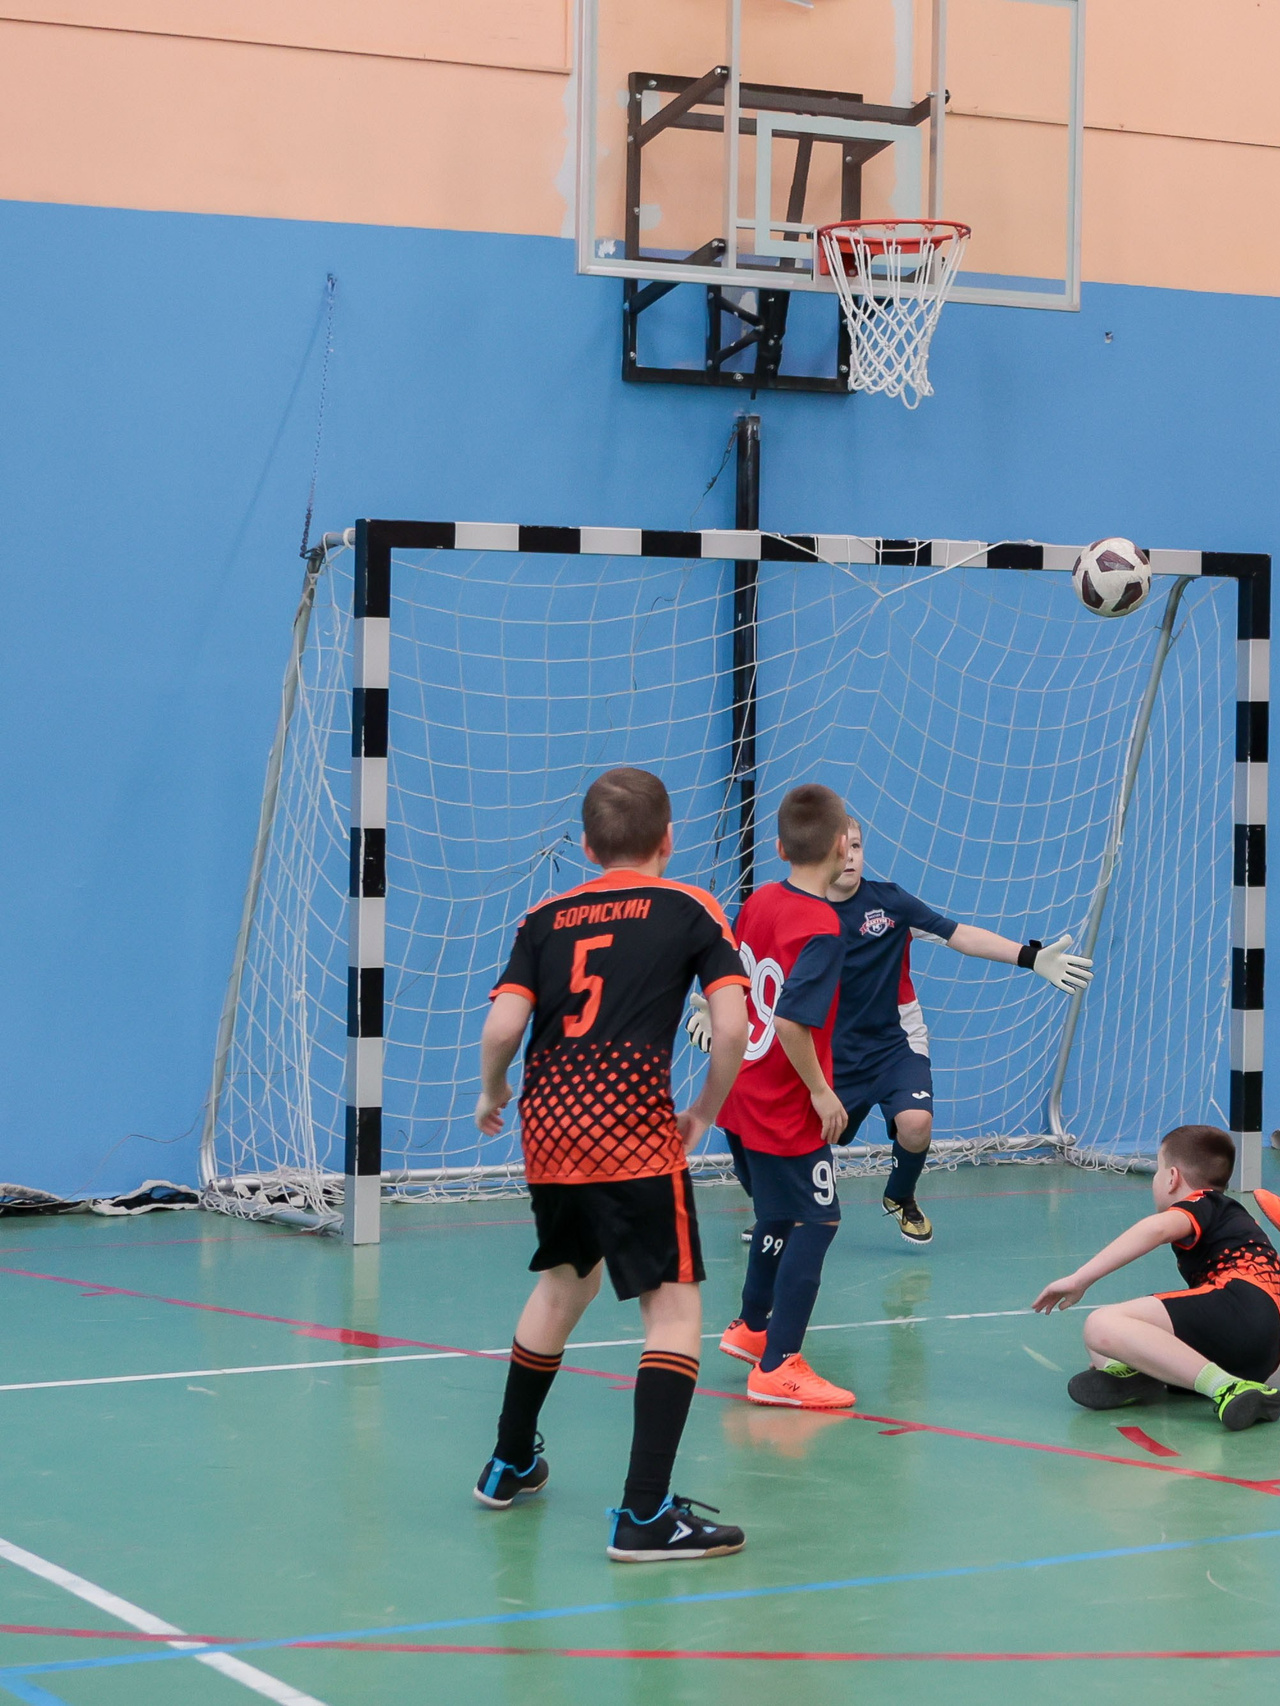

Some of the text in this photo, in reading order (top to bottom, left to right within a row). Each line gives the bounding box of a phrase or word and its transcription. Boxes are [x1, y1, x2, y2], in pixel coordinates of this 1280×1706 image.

[553, 898, 652, 931] БОРИСКИН
[562, 933, 614, 1038] 5
[739, 940, 785, 1061] 9
[812, 1160, 837, 1206] 9
[761, 1234, 784, 1257] 99
